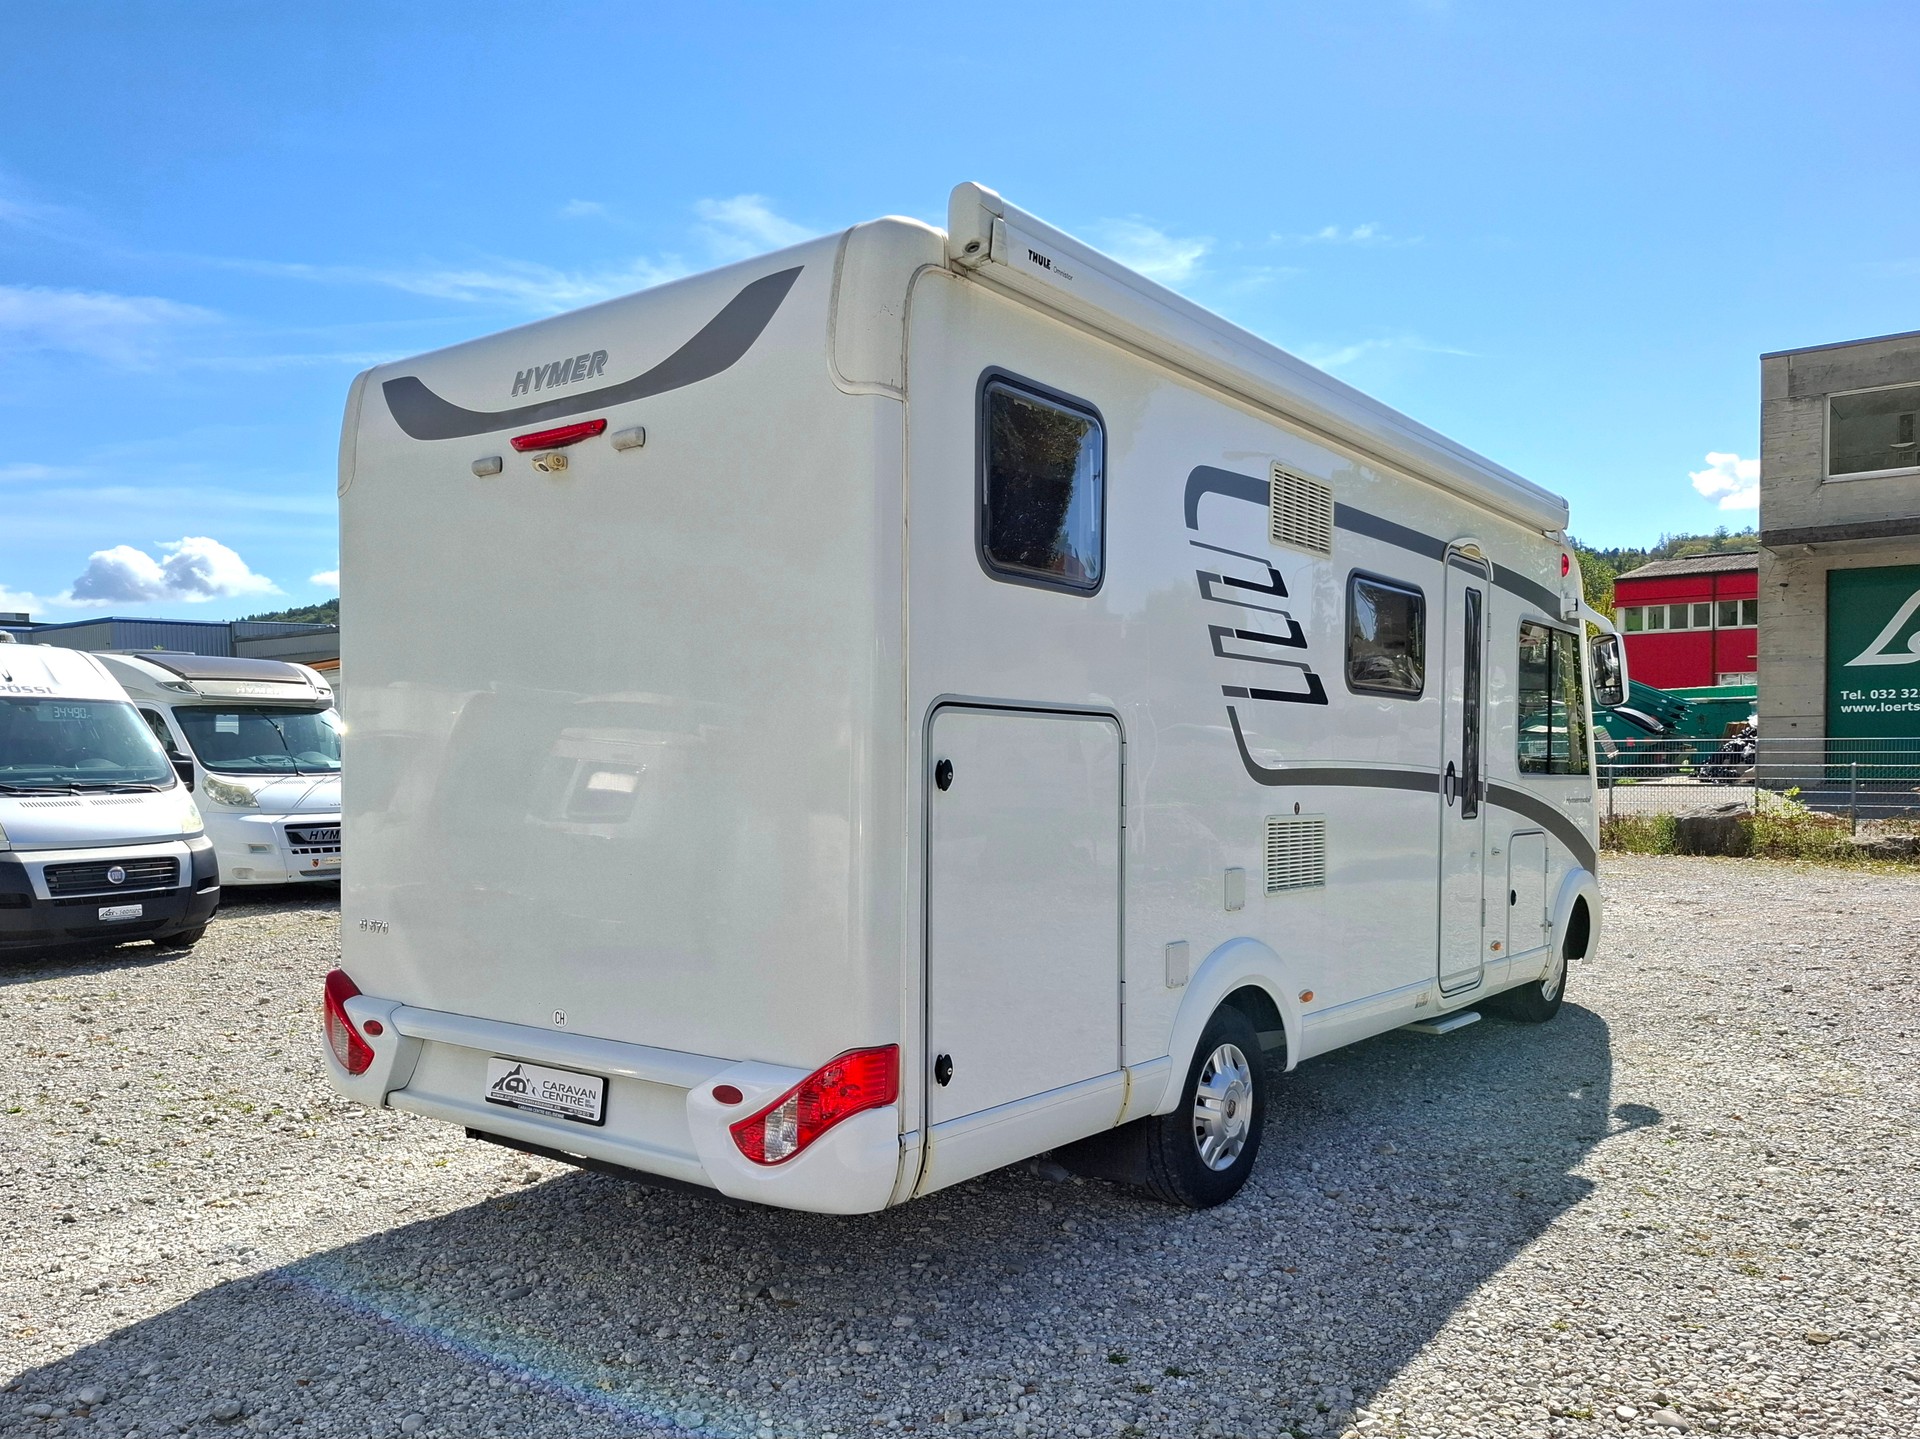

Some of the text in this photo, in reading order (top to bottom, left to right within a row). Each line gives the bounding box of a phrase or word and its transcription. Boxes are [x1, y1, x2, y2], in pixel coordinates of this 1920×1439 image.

[1028, 249, 1051, 270] THULE
[511, 349, 608, 397] HYMER
[1840, 688, 1920, 700] Tel. 032 32
[555, 1011, 564, 1025] CH
[542, 1090, 584, 1106] CENTRE
[543, 1080, 596, 1100] CARAVAN
